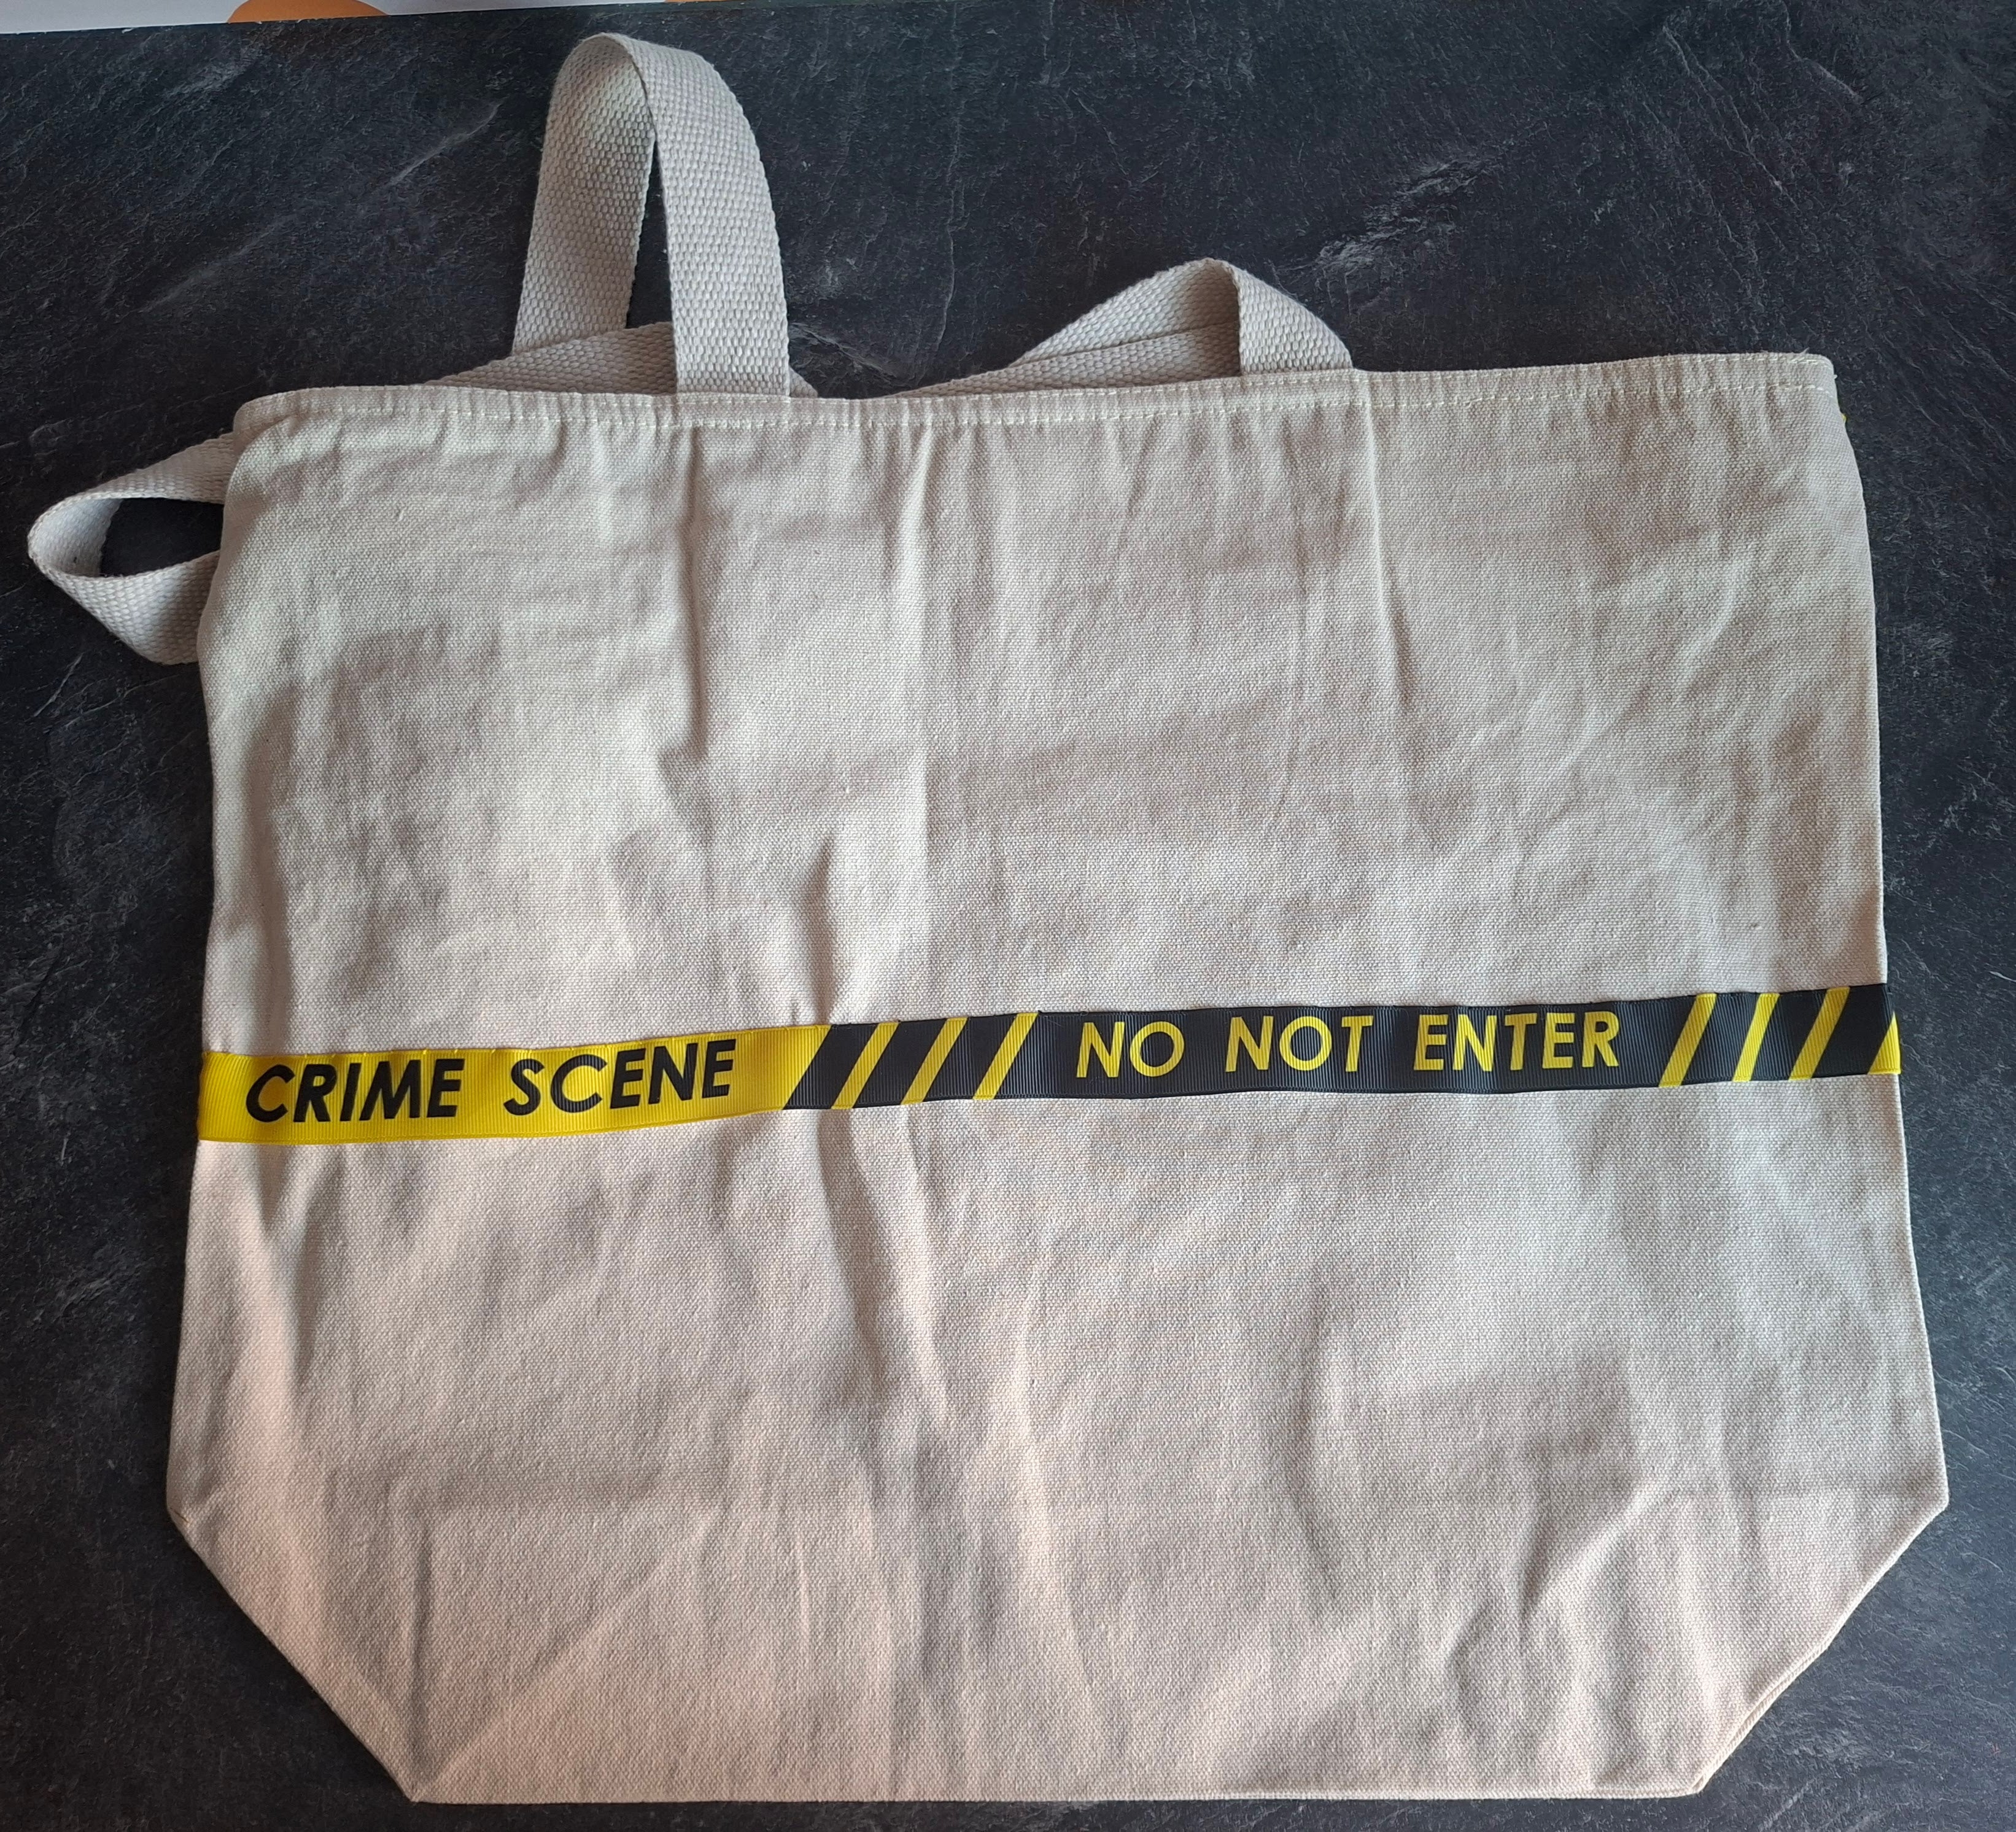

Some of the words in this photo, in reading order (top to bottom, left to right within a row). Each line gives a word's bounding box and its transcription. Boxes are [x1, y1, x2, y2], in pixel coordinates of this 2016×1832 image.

[246, 1057, 465, 1122] CRIME
[503, 1039, 737, 1116] SCENE
[1076, 1020, 1185, 1078] NO
[1225, 1015, 1373, 1073] NOT
[1413, 1012, 1621, 1071] ENTER
